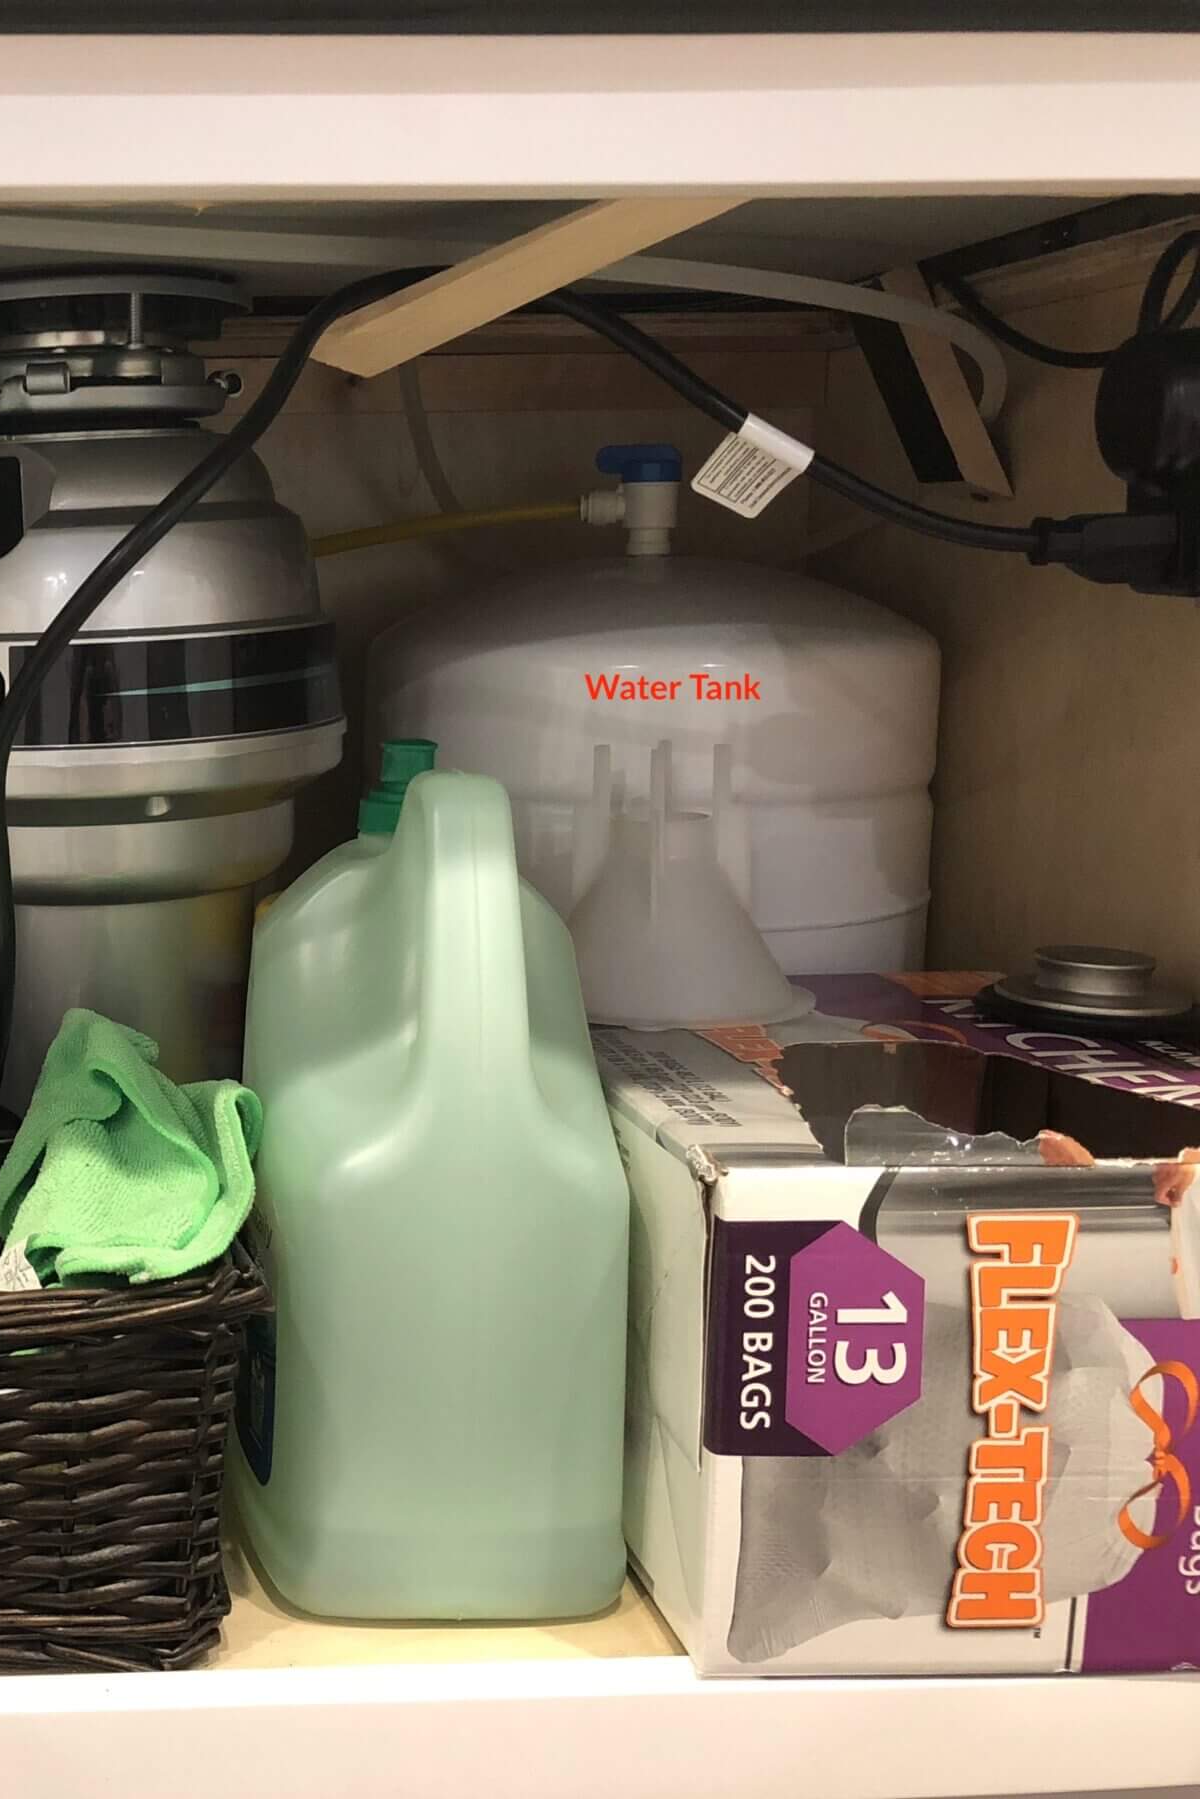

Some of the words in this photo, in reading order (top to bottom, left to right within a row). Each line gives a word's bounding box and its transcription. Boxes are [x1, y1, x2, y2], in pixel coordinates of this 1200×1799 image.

[743, 1254, 776, 1319] 200
[739, 1332, 774, 1430] BAGS
[806, 1291, 829, 1384] GALLON
[834, 1290, 908, 1385] 13
[946, 1213, 1080, 1629] FLEX-TECH
